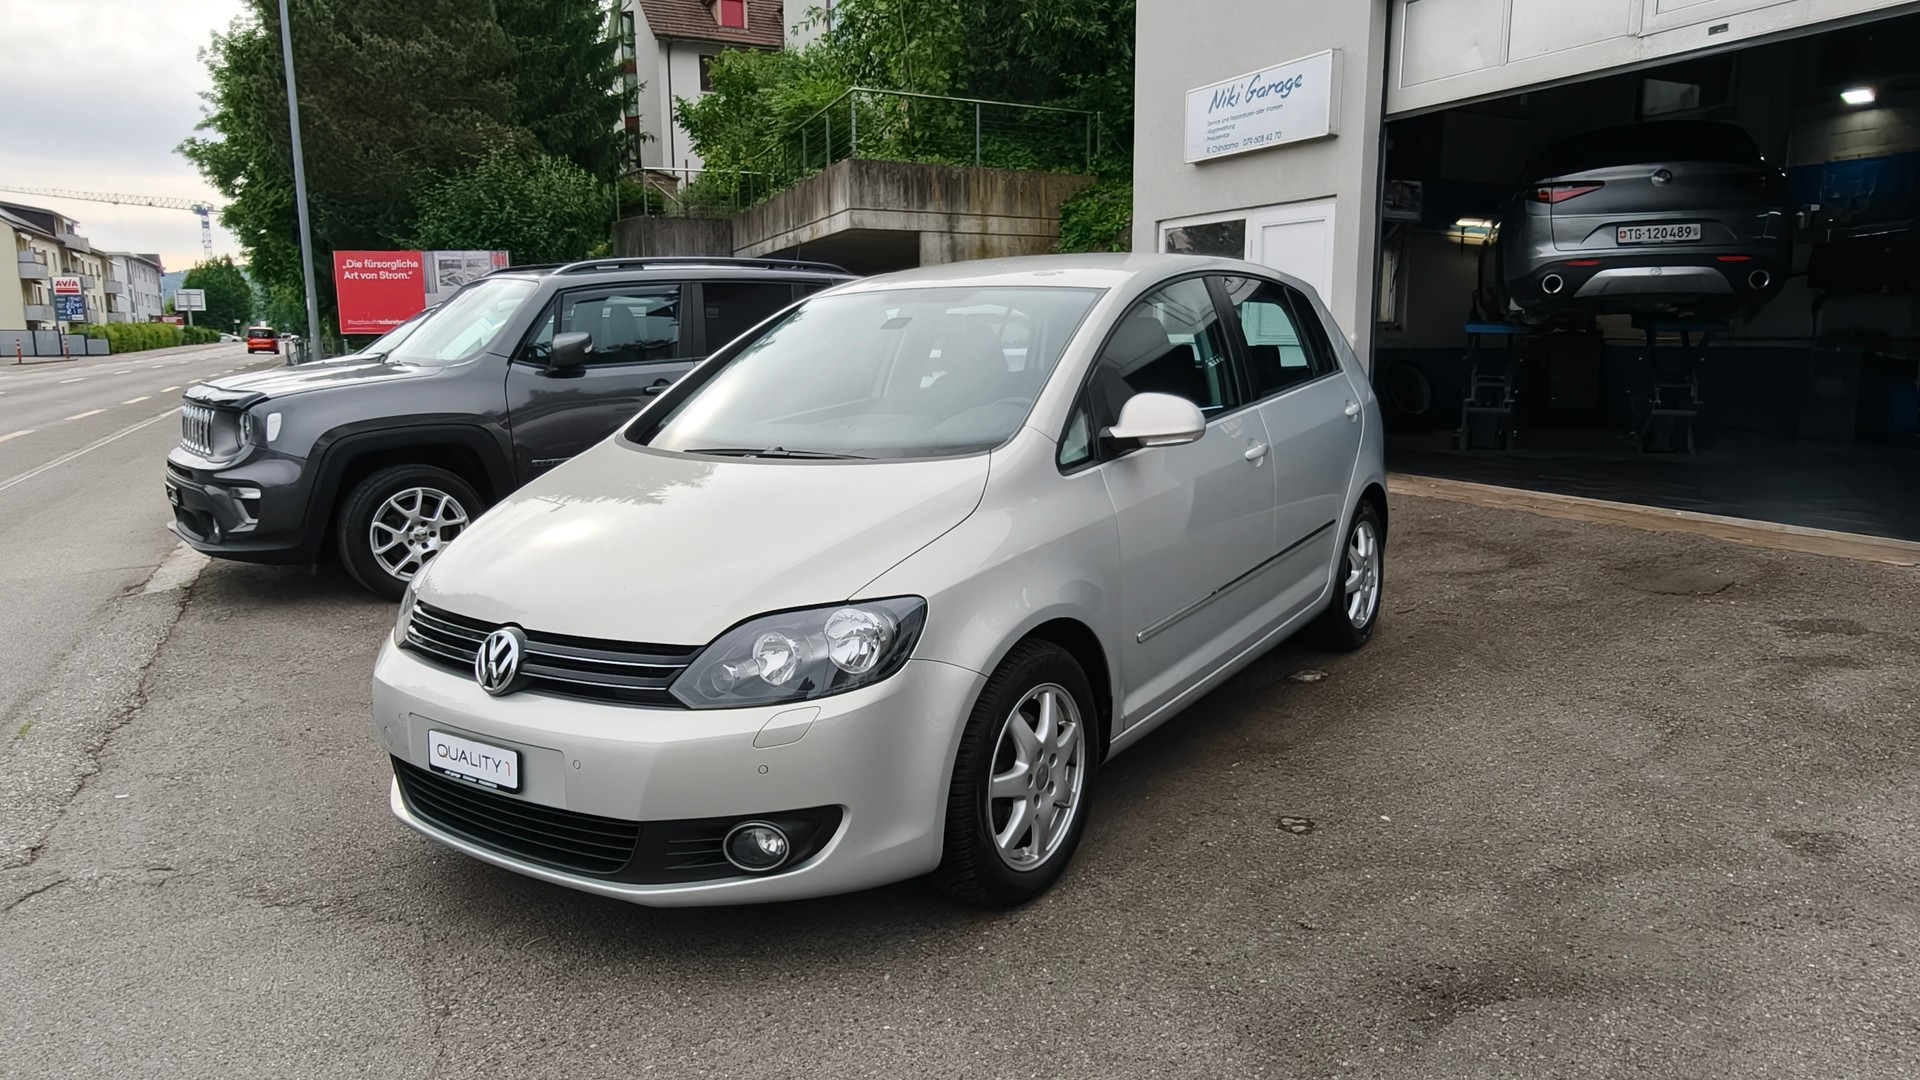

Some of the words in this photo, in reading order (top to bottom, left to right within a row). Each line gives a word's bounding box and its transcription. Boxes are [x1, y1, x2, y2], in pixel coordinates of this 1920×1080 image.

[1208, 84, 1243, 114] Niki
[1245, 74, 1303, 103] Garage
[1242, 136, 1254, 146] 079
[1274, 131, 1282, 140] 70
[364, 259, 419, 270] fürsorgliche
[343, 271, 359, 280] Art
[55, 279, 78, 287] AVIA
[436, 743, 502, 773] QUALITY
